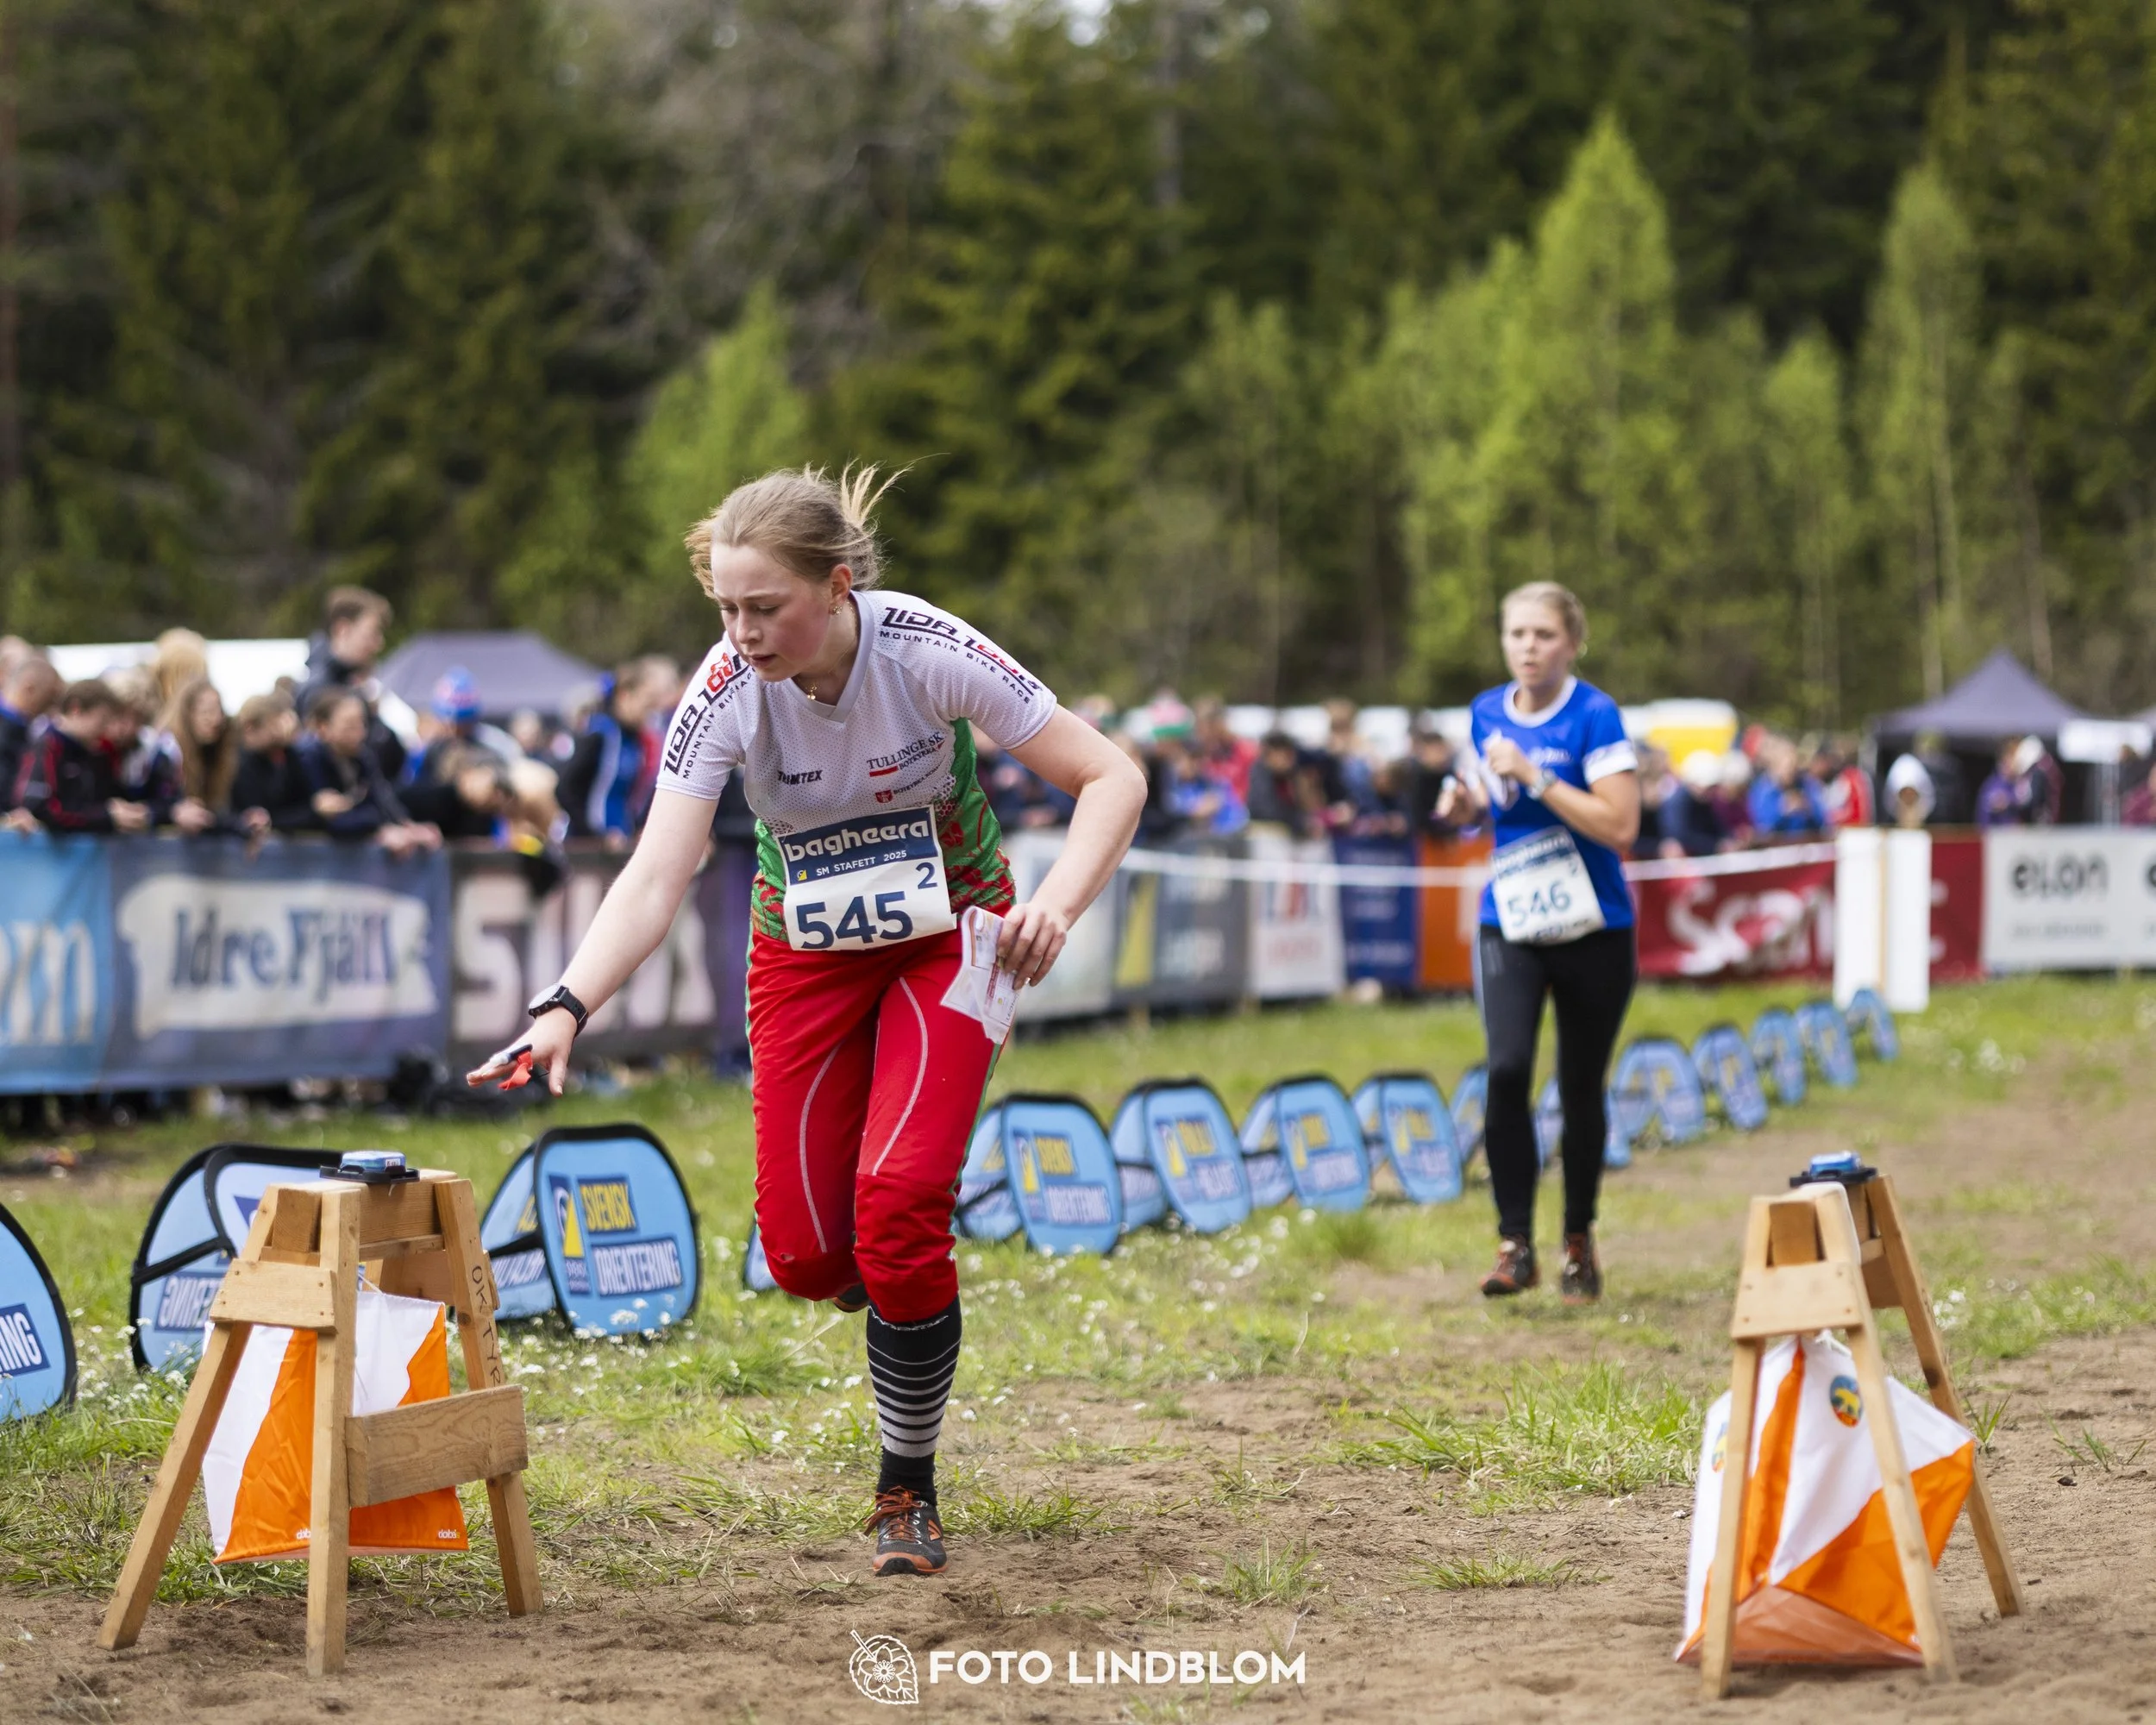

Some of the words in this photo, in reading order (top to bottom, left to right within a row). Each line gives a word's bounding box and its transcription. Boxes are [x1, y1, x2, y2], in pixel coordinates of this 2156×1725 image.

[880, 630, 958, 653] MOUNTAIN
[966, 652, 997, 674] BIKE
[1002, 675, 1031, 705] RACE
[867, 739, 927, 770] TULLINGE
[928, 731, 945, 747] SK
[784, 820, 931, 863] bagheera
[816, 867, 830, 877] SM
[834, 856, 876, 874] STAFETT
[883, 850, 907, 862] 2025
[915, 862, 938, 890] 2
[795, 890, 914, 950] 545
[1506, 880, 1572, 930] 546
[580, 1182, 636, 1232] SVENSK
[593, 1239, 683, 1295] ORIENTERING
[0, 1311, 42, 1374] ING
